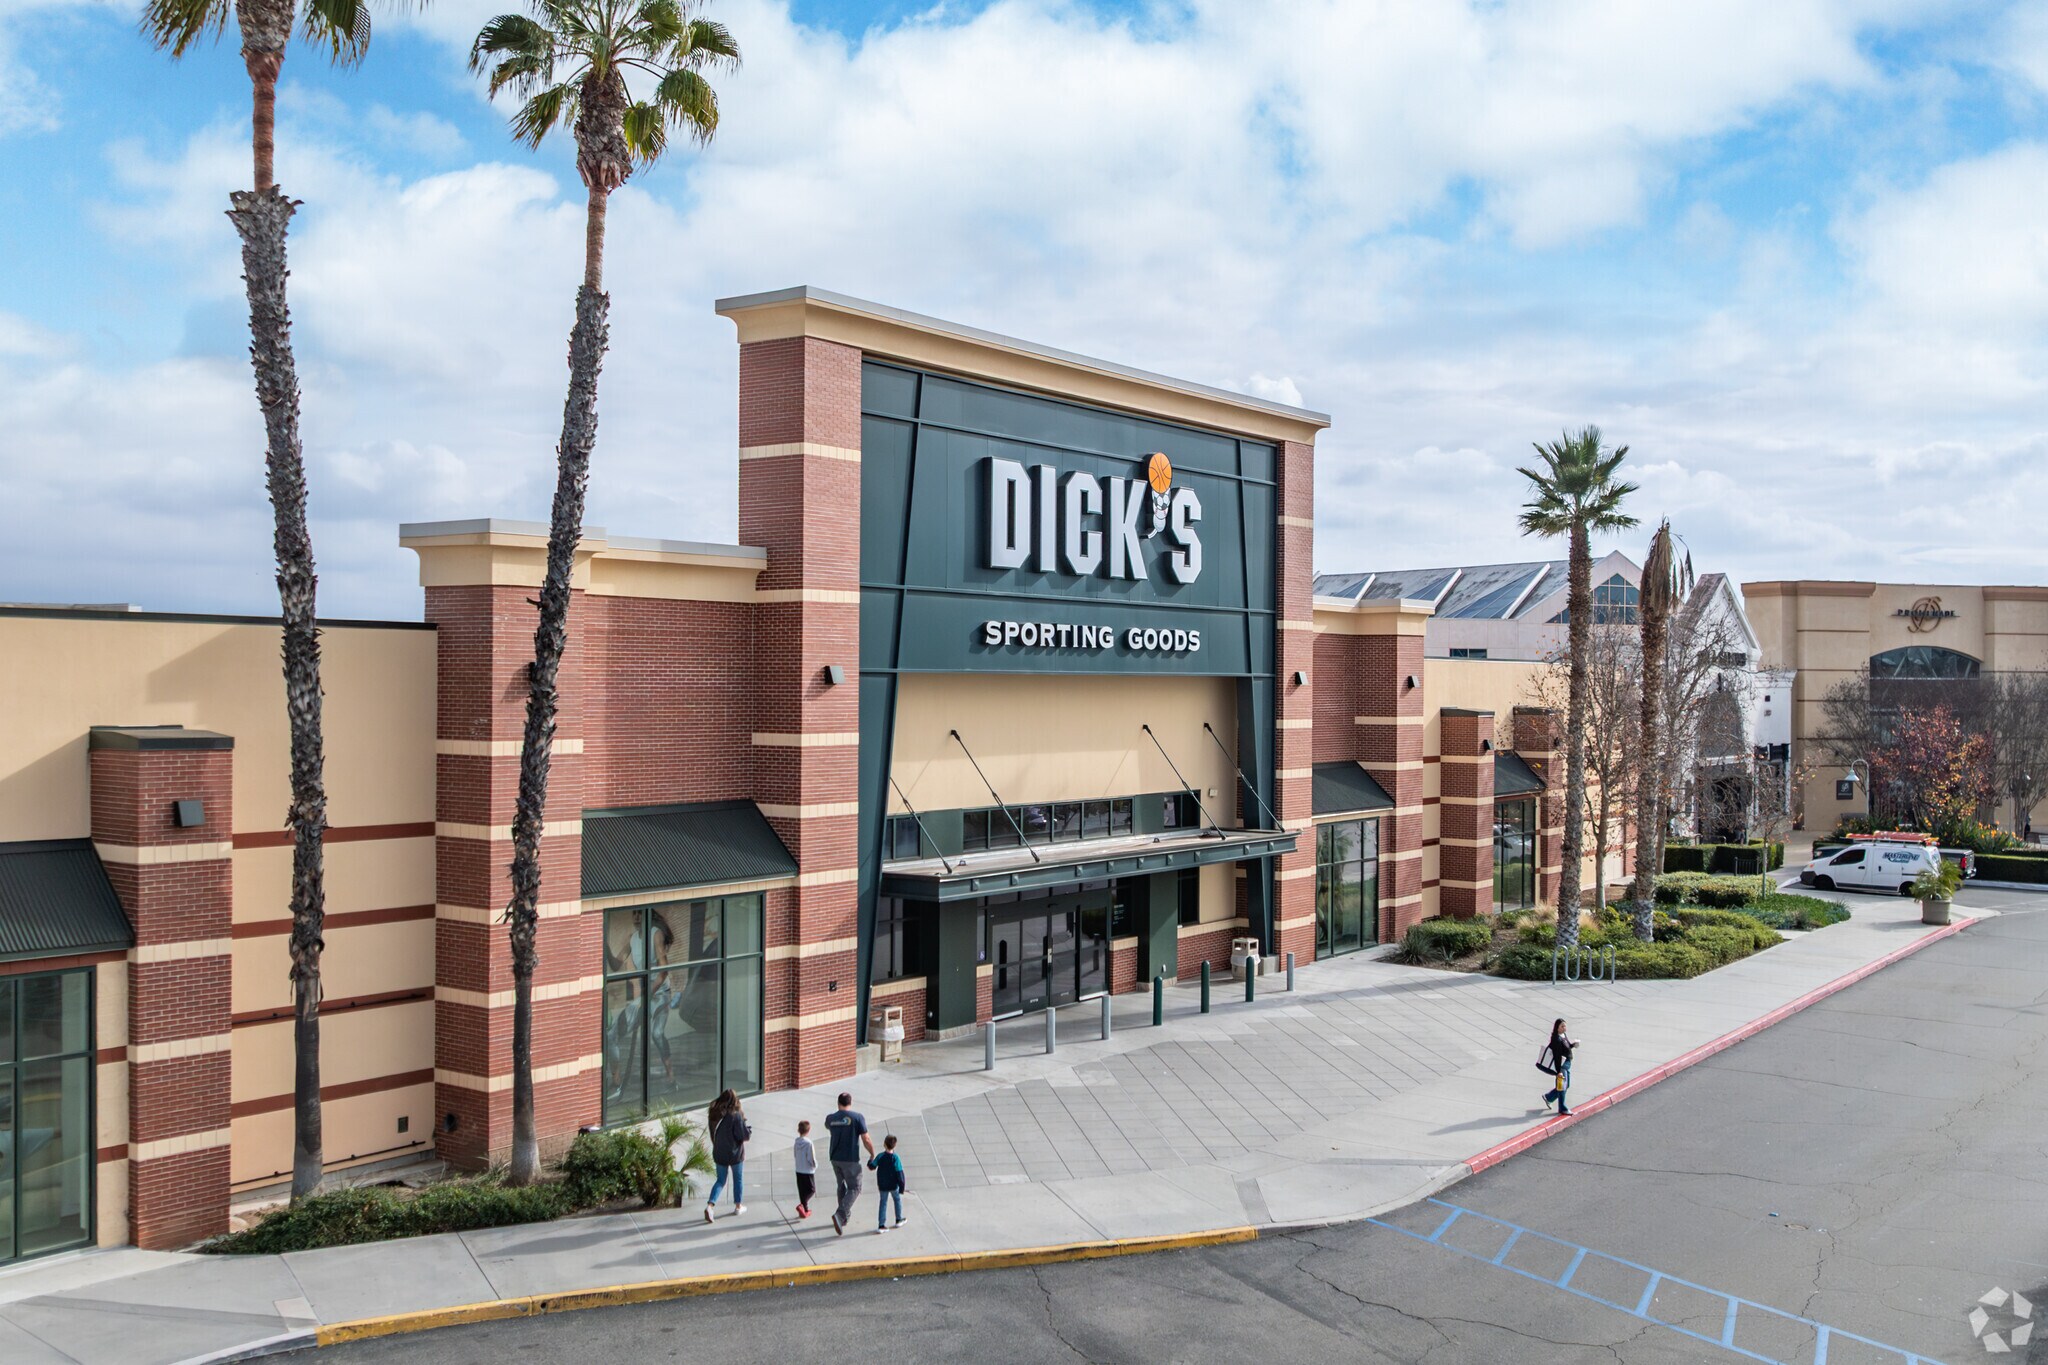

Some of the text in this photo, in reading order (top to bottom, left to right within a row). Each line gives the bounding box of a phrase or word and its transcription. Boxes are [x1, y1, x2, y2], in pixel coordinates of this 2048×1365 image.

[986, 453, 1202, 584] DICK'S
[984, 620, 1201, 652] SPORTING GOODS
